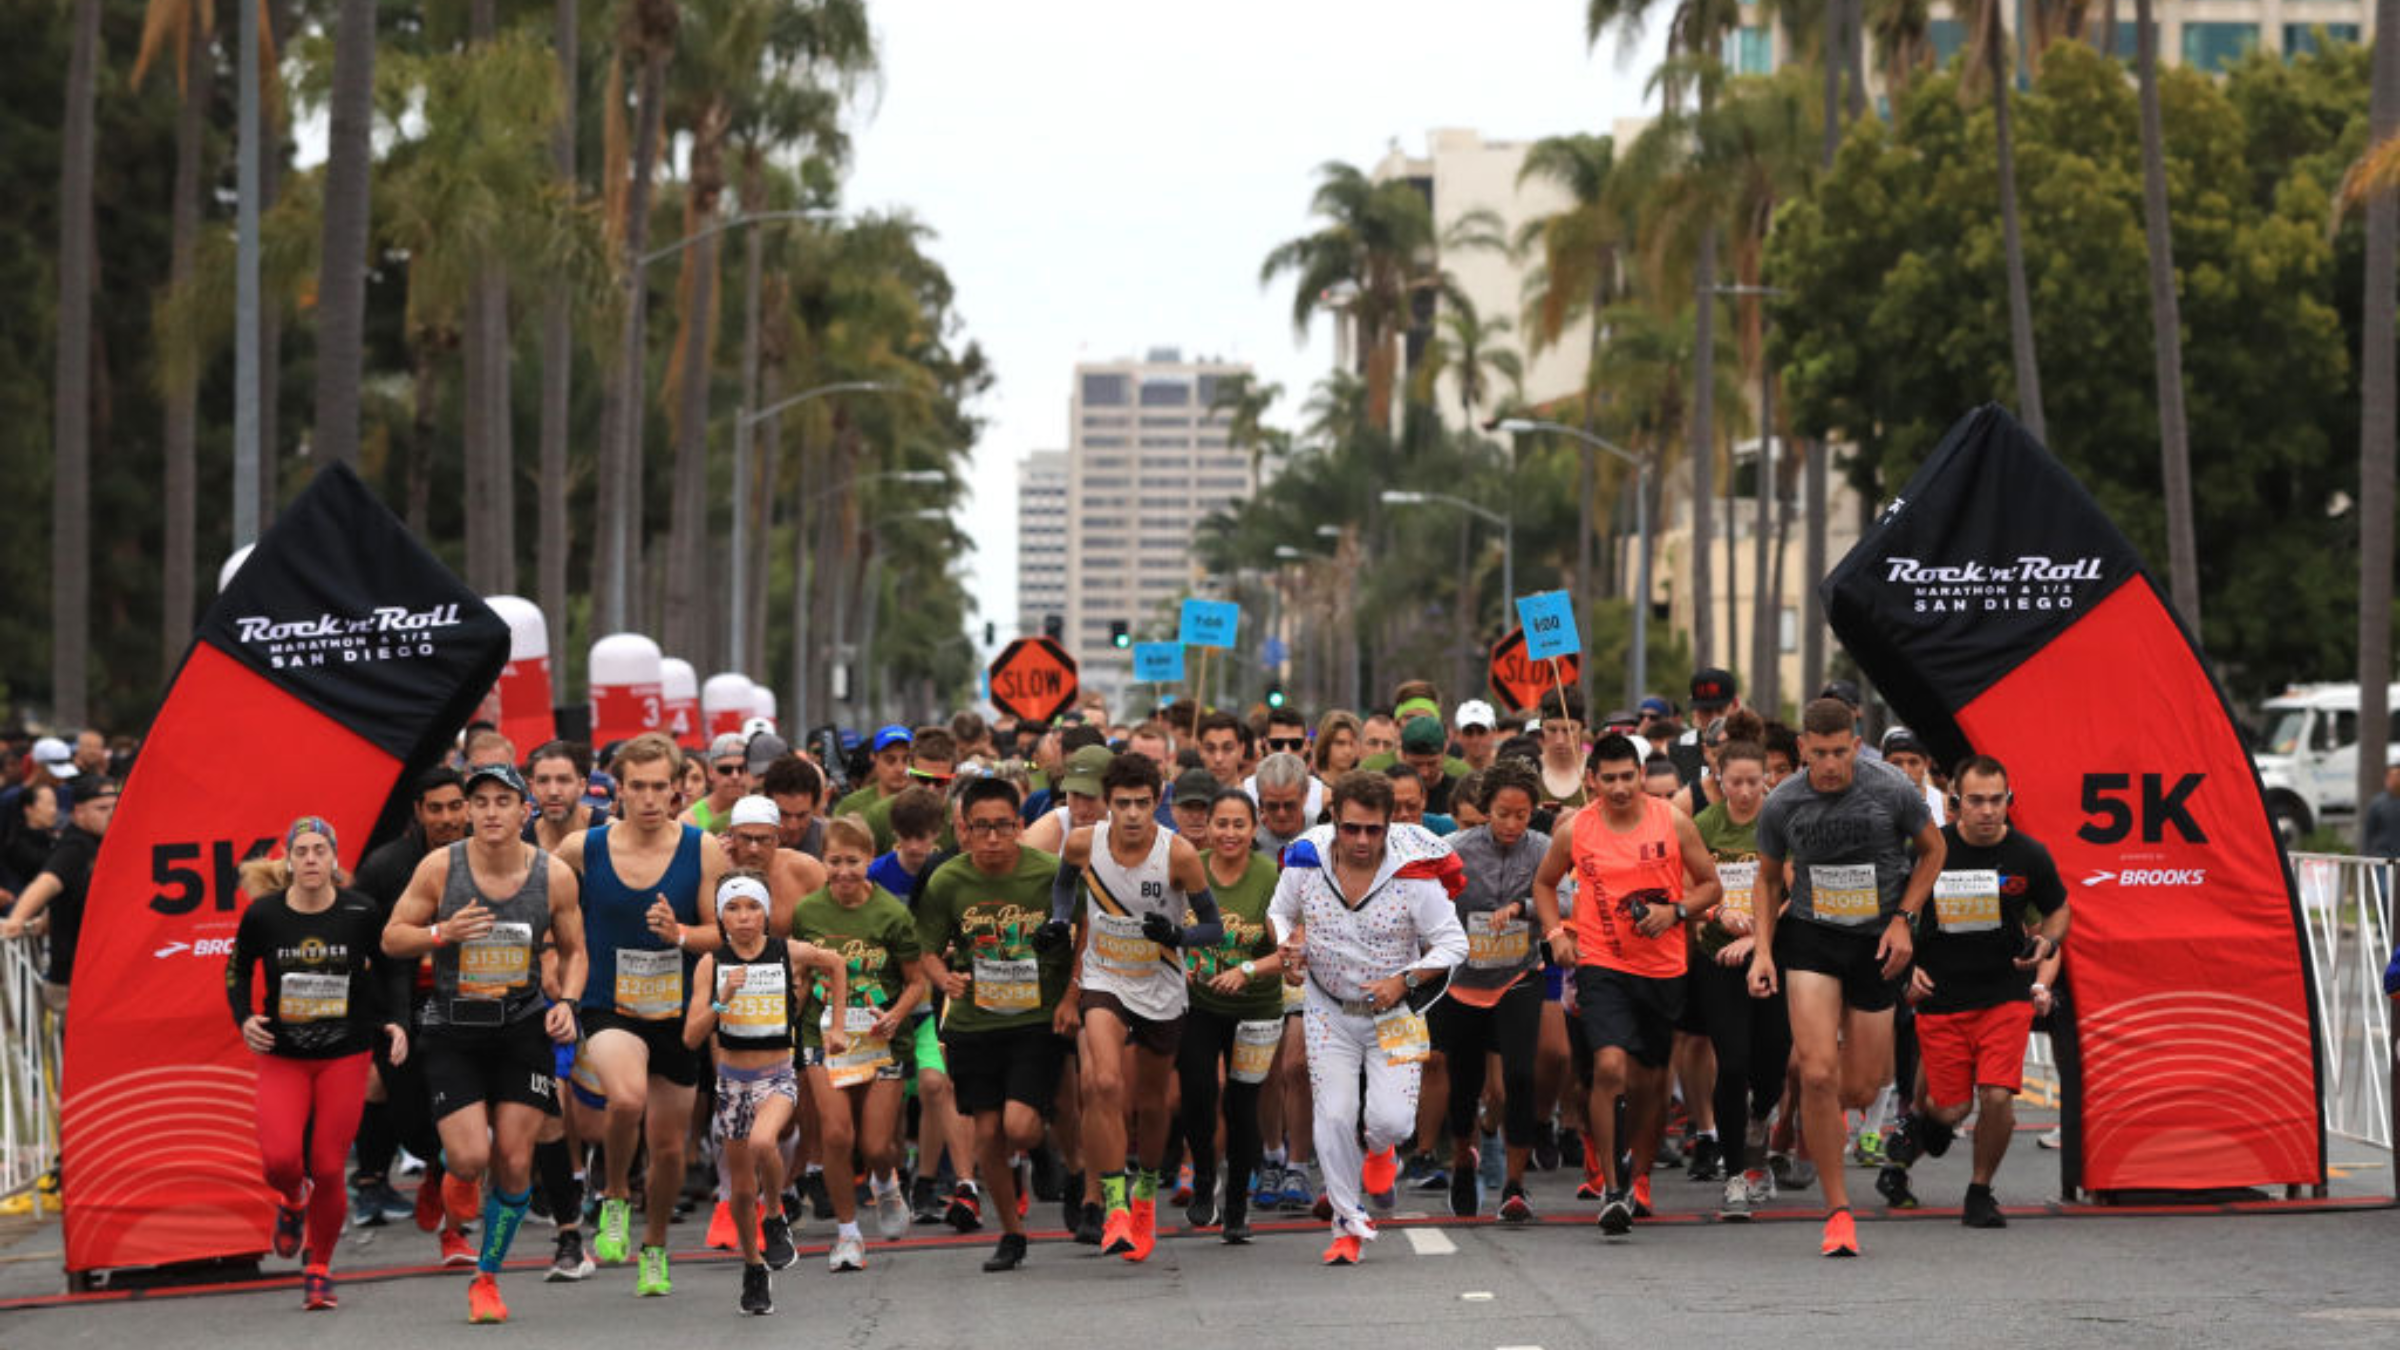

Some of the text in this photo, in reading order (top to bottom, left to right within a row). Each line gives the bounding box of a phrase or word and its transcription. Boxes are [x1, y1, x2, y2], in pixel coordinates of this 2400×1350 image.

[1914, 585, 2007, 596] MARATHON
[1914, 597, 2074, 613] SAN DIEGO
[269, 636, 367, 654] MARATHON
[271, 643, 434, 669] SAN DIEGO
[1002, 666, 1062, 699] SLOW
[643, 698, 660, 728] 3
[2076, 772, 2210, 845] 5K
[149, 838, 278, 916] 5K
[2118, 868, 2207, 887] BROOKS
[194, 937, 237, 957] BRO
[723, 997, 785, 1017] 2535
